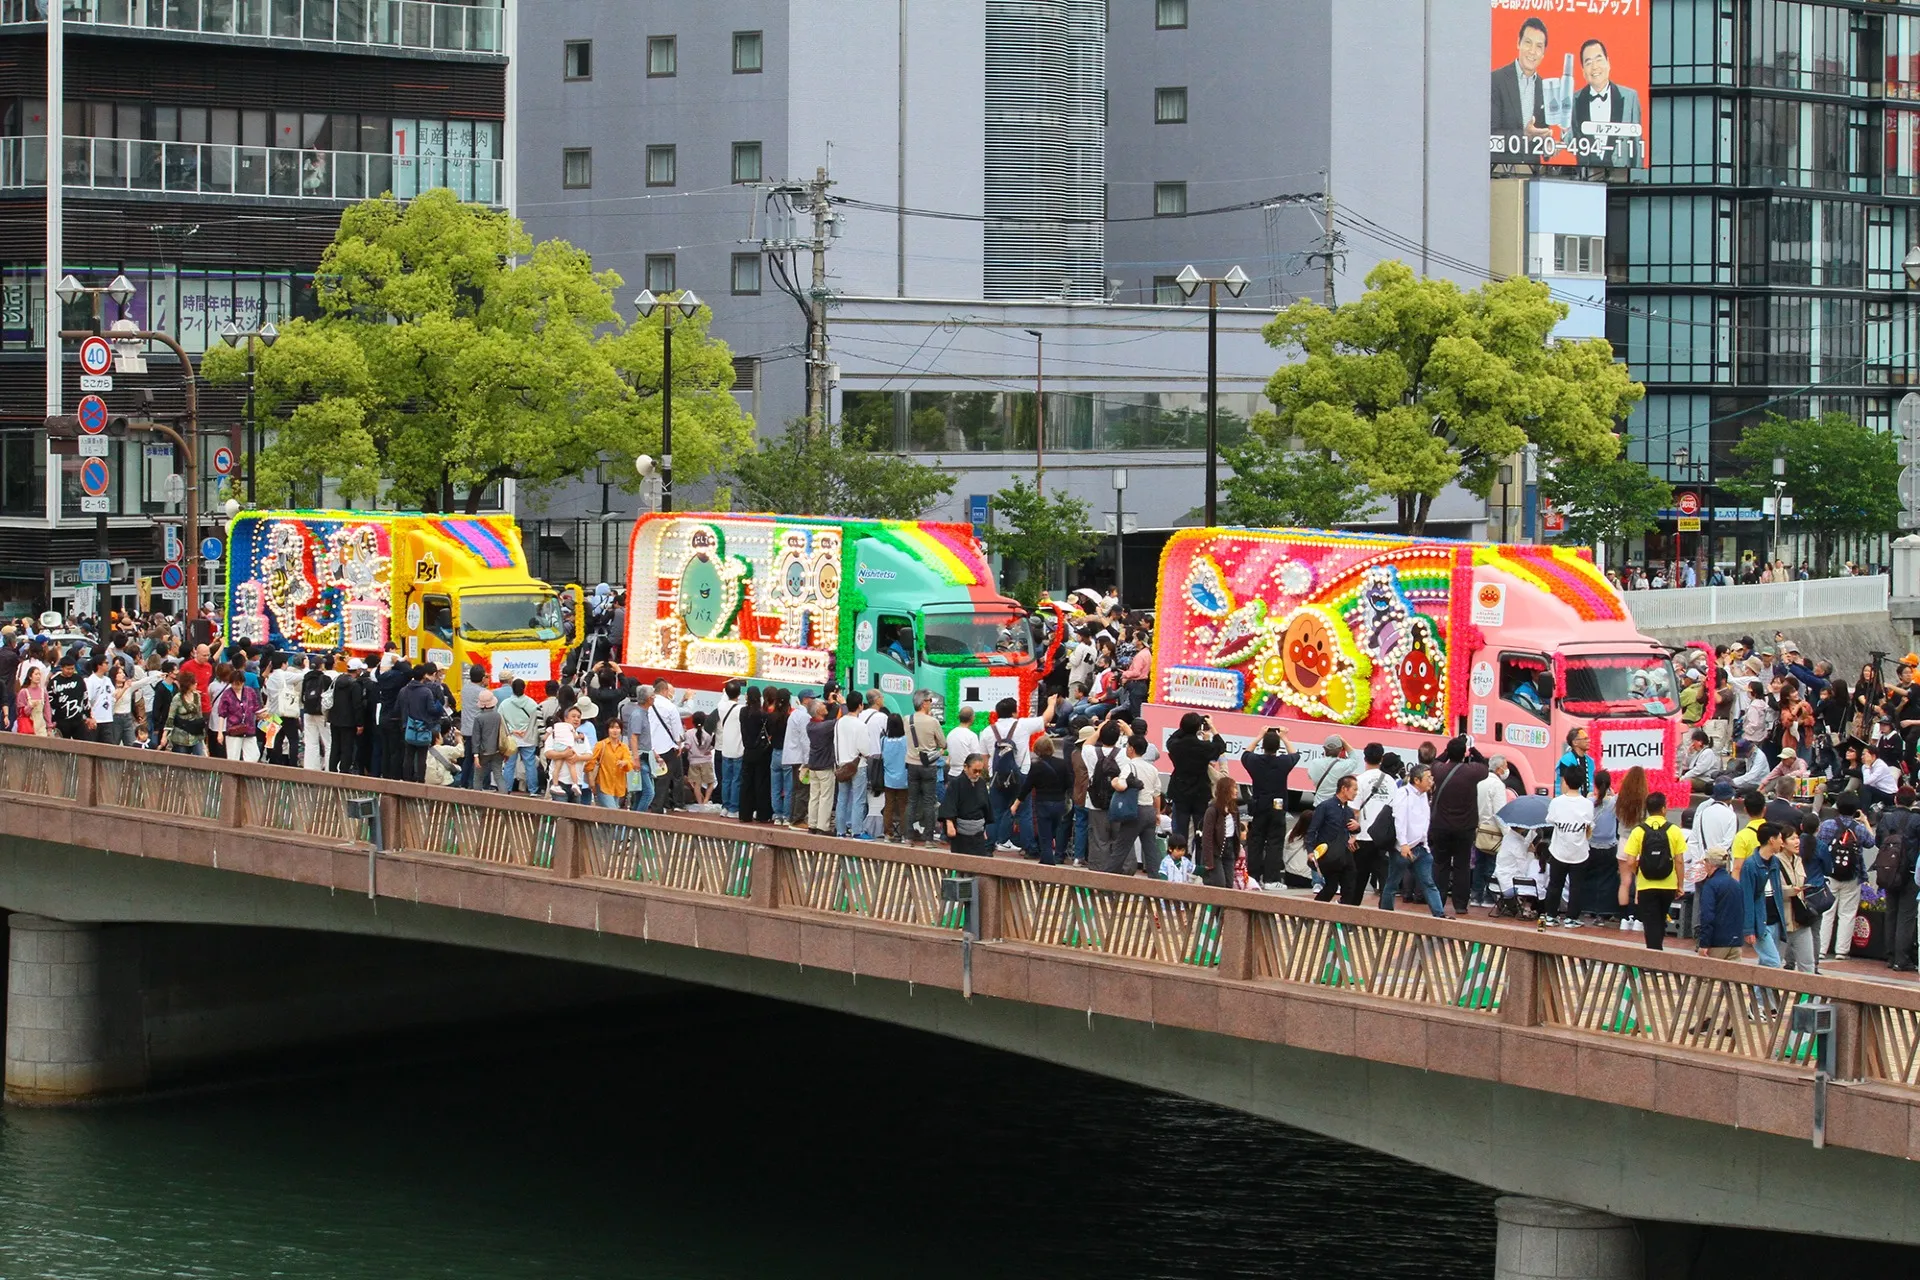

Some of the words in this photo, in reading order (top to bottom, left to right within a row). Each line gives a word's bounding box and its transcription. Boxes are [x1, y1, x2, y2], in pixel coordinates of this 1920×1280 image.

[1595, 125, 1622, 134] ルアン
[1508, 135, 1646, 159] 0120-494-111
[87, 348, 105, 364] 40
[82, 379, 111, 388] ここから
[84, 500, 107, 509] 2-16
[857, 567, 896, 579] Nishitetsu
[695, 610, 713, 623] バス
[503, 661, 539, 669] Nishitetsu
[1601, 742, 1663, 758] HITACHI
